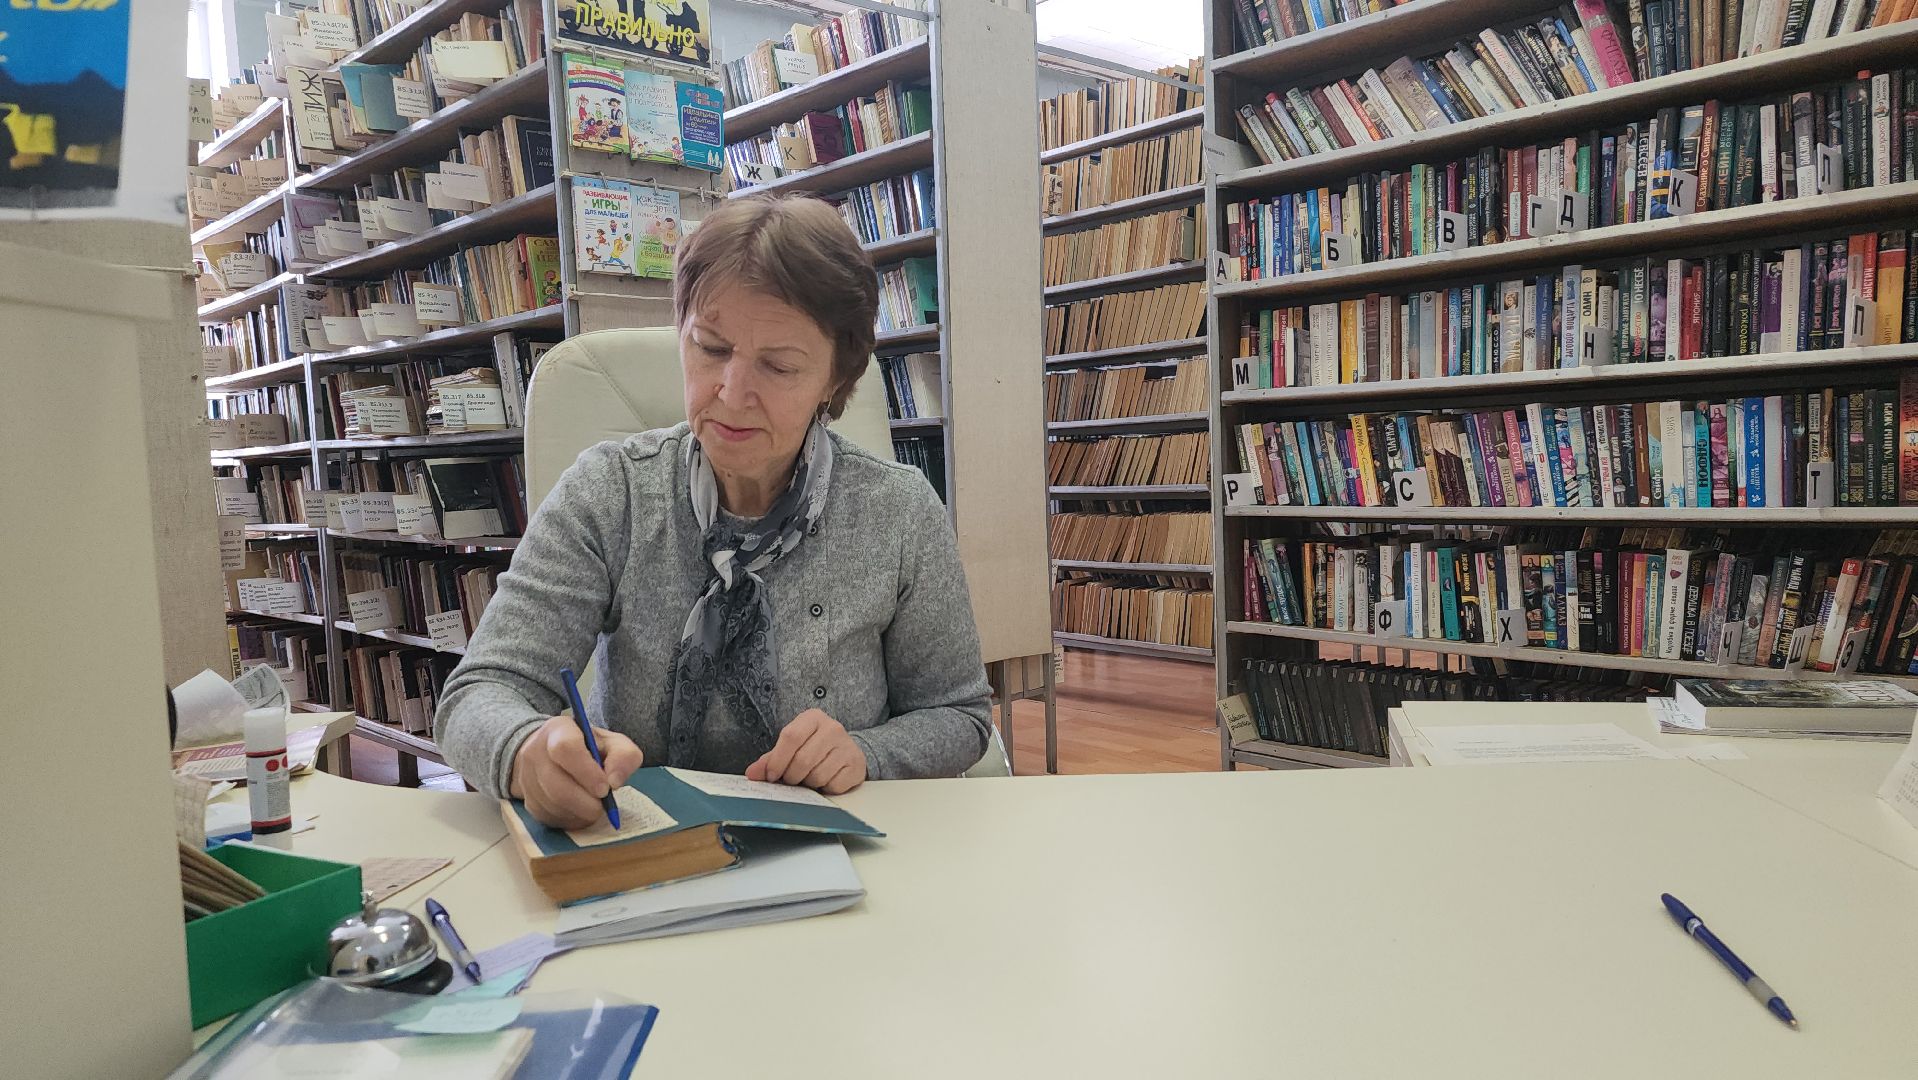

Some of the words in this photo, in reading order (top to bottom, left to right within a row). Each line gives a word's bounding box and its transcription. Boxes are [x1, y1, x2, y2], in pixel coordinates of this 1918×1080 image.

[575, 2, 696, 48] ПРАВИЛЬНО
[1700, 115, 1714, 158] Свияжске
[783, 146, 796, 161] К
[1717, 150, 1731, 185] КЕЙН
[746, 164, 762, 181] Ж
[1821, 153, 1832, 186] Л
[1671, 177, 1684, 208] К
[1697, 167, 1710, 207] Сказание
[584, 208, 597, 216] ДЛЯ
[598, 210, 629, 219] МАЛЫШЕЙ
[591, 198, 621, 211] ИГРЫ
[1531, 202, 1543, 229] Г
[1560, 194, 1574, 229] Д
[1443, 217, 1456, 244] В
[1326, 237, 1340, 262] Б
[1216, 257, 1228, 280] А
[1582, 291, 1592, 317] ОДИН
[1693, 292, 1701, 324] ЯПОНИЯ
[1853, 304, 1865, 337] П
[1584, 331, 1595, 360] Н
[1235, 362, 1250, 386] М
[1883, 401, 1893, 426] МОРЯ
[1384, 422, 1397, 452] ПАРИЖ
[1882, 428, 1893, 461] ТАЙНЫ
[1226, 479, 1239, 501] Р
[1399, 477, 1414, 502] С
[1651, 469, 1663, 500] Свифт
[1811, 470, 1821, 500] Т
[1378, 608, 1392, 632] Ф
[1499, 616, 1513, 643] Х
[1723, 630, 1734, 658] Ч
[1840, 639, 1854, 668] Э
